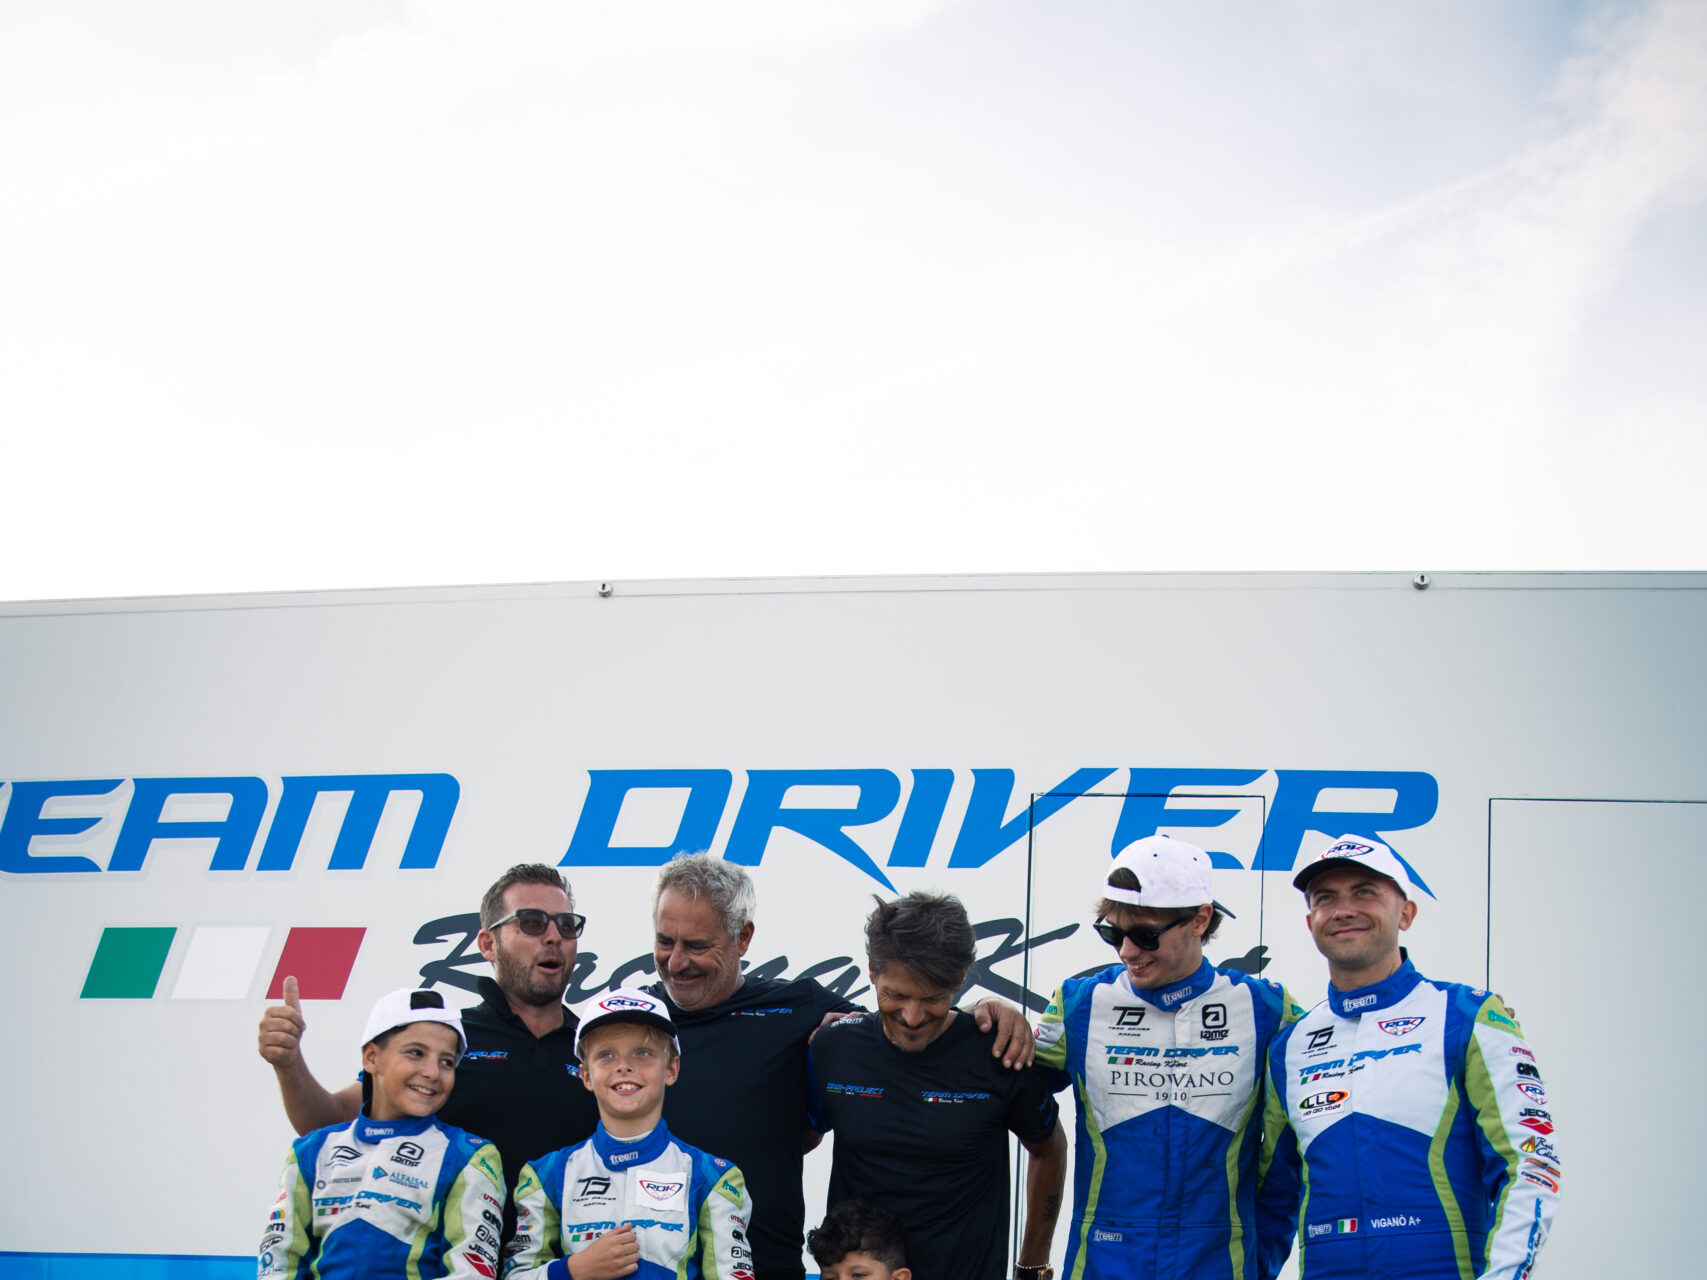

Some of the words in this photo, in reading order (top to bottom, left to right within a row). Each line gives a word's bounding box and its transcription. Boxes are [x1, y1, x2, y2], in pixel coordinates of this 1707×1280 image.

[0, 773, 460, 874] EAM
[556, 768, 1437, 900] DRIVER
[1161, 986, 1192, 1006] freem
[1343, 994, 1377, 1012] freem
[1384, 1019, 1418, 1028] ROK
[1105, 1045, 1160, 1057] TEAM
[1299, 1059, 1345, 1077] TEAM
[1110, 1070, 1235, 1088] PIROVANO
[610, 1151, 639, 1165] freem
[645, 1182, 677, 1192] ROK
[567, 1221, 617, 1233] TEAM
[1408, 1216, 1422, 1227] A+
